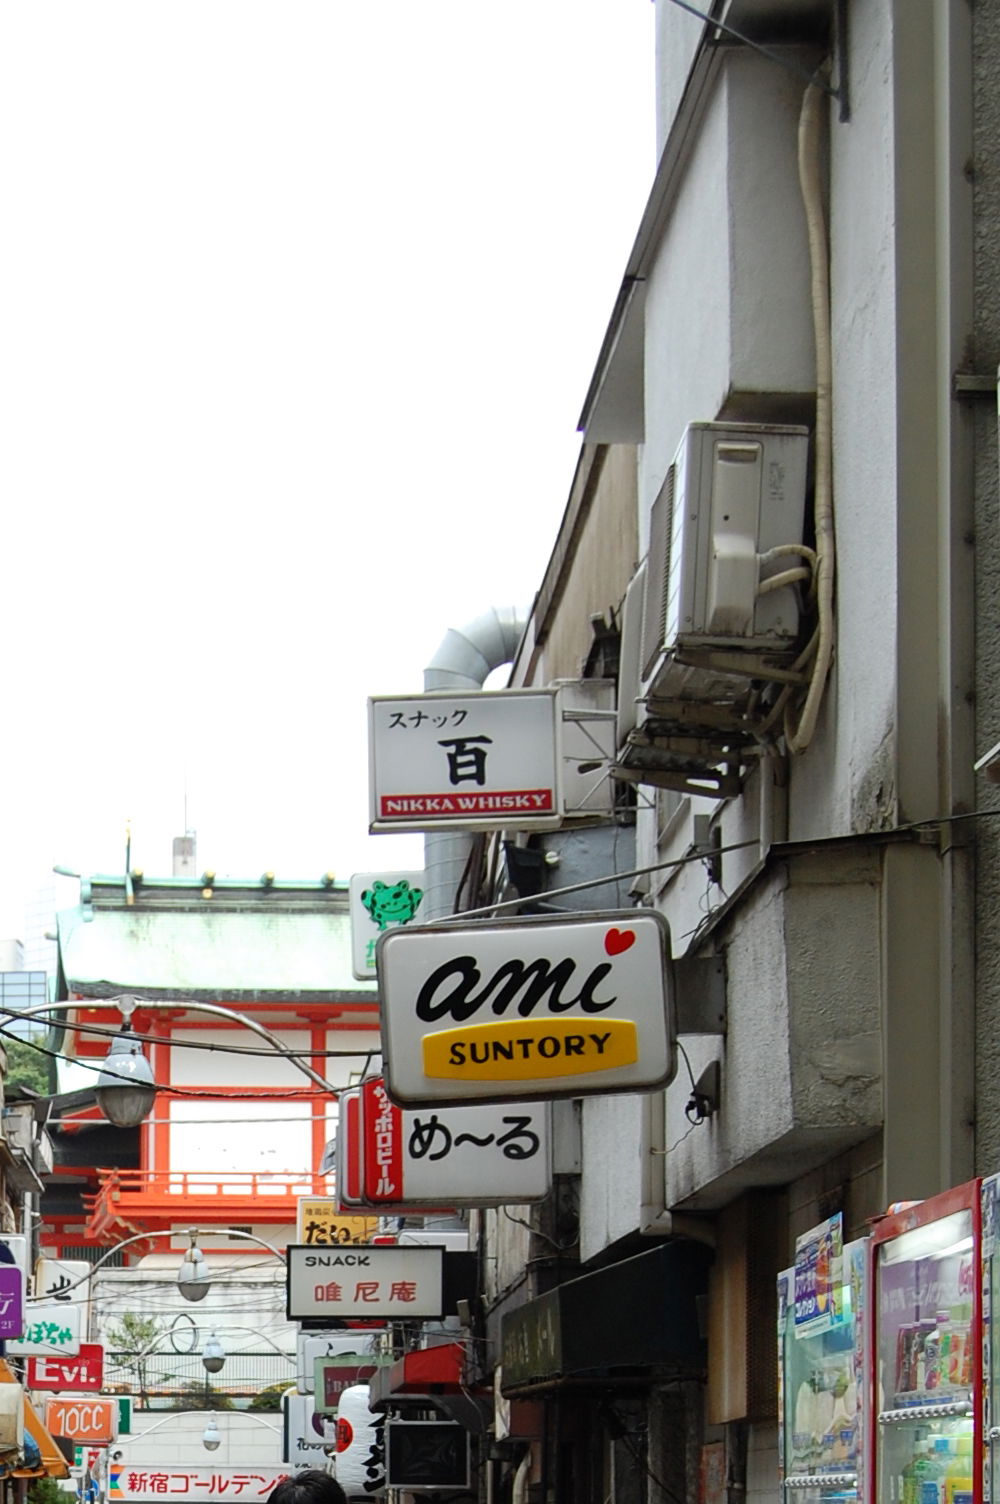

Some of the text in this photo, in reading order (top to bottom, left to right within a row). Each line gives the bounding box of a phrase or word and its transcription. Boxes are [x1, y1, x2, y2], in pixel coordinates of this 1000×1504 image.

[388, 709, 468, 729] スナック
[437, 734, 493, 786] 百
[386, 794, 547, 813] NIKKA WHISKY
[416, 955, 618, 1023] ami
[449, 1032, 612, 1066] SUNTORY
[305, 1254, 371, 1267] SNACK
[0, 1320, 16, 1330] 2F
